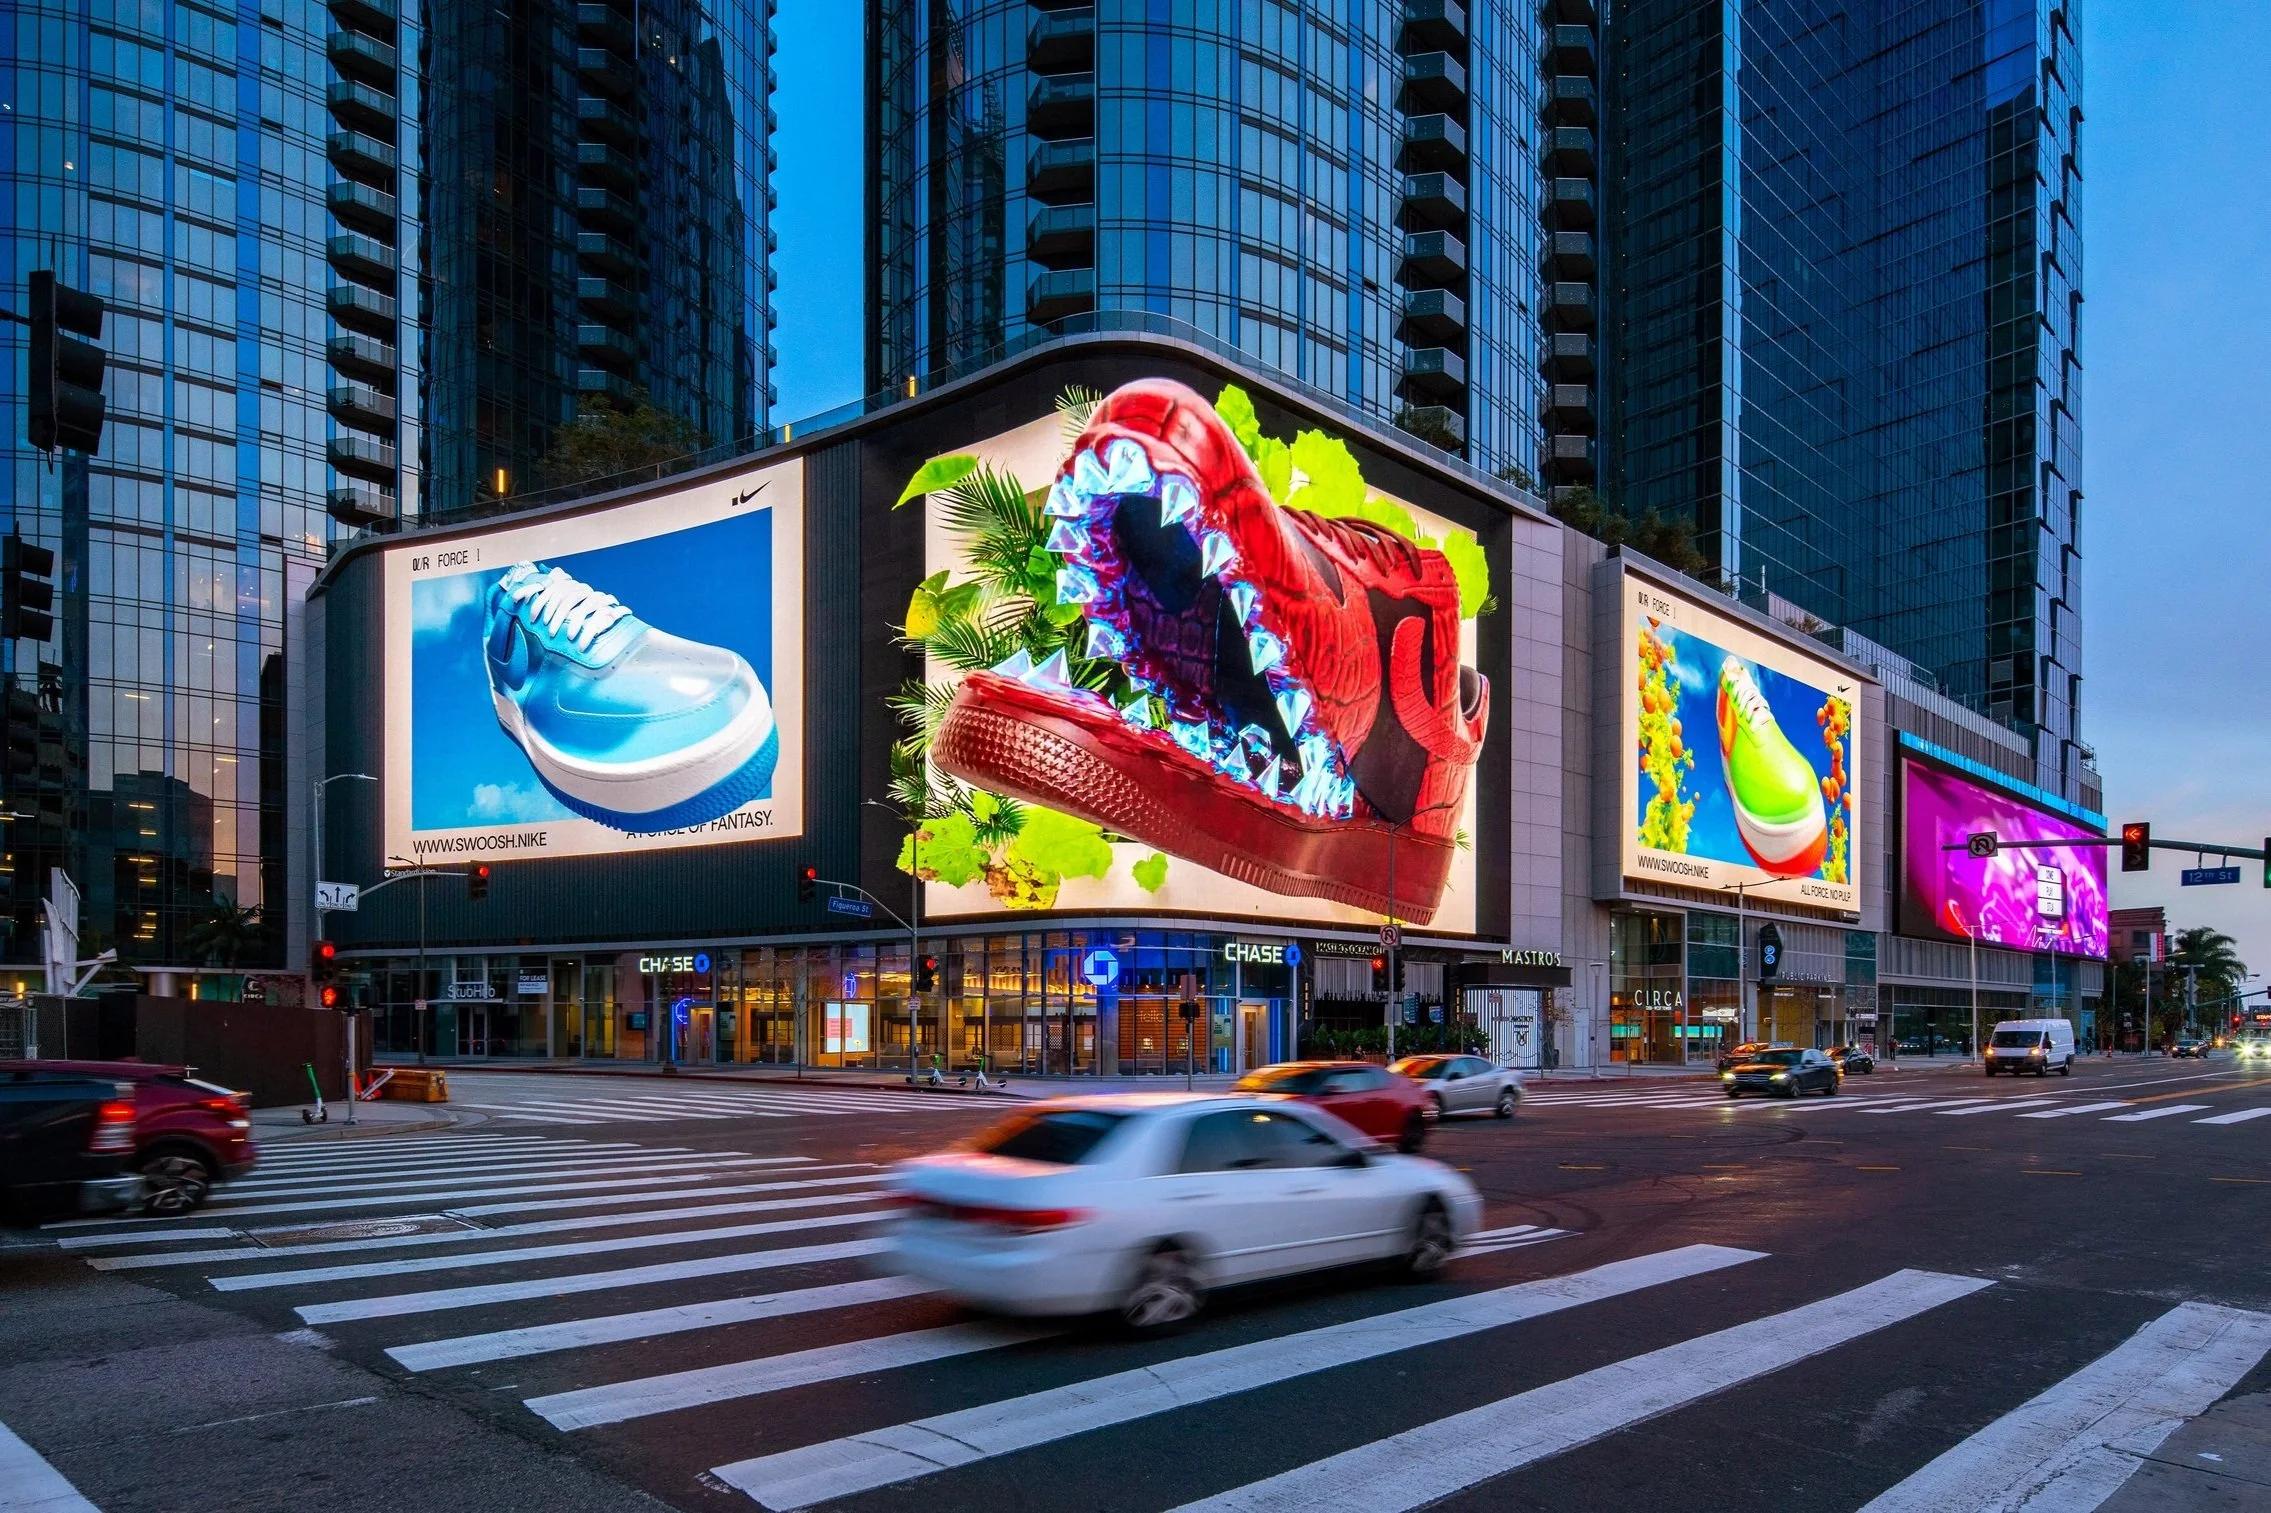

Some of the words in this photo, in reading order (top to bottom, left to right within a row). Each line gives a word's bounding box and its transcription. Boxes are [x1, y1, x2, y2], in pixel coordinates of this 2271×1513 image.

[438, 550, 468, 567] FORCE
[1653, 597, 1670, 616] FORCE
[711, 809, 773, 831] FANTASY.
[412, 831, 547, 854] WWW.SWOOSH.NIKE
[1637, 854, 1709, 879] WWW.SWOOSH.NIKE
[2219, 871, 2232, 880] St
[1801, 884, 1811, 896] ALL
[1829, 889, 1838, 900] NO
[832, 900, 860, 911] Figueroa
[861, 905, 869, 913] St
[1224, 943, 1284, 963] CHASE
[1502, 949, 1561, 967] MASTRO'S
[639, 956, 694, 973] CHASE
[1781, 971, 1805, 981] PUBLIC
[1806, 973, 1832, 982] PARKING
[1634, 989, 1683, 1007] CIRCA
